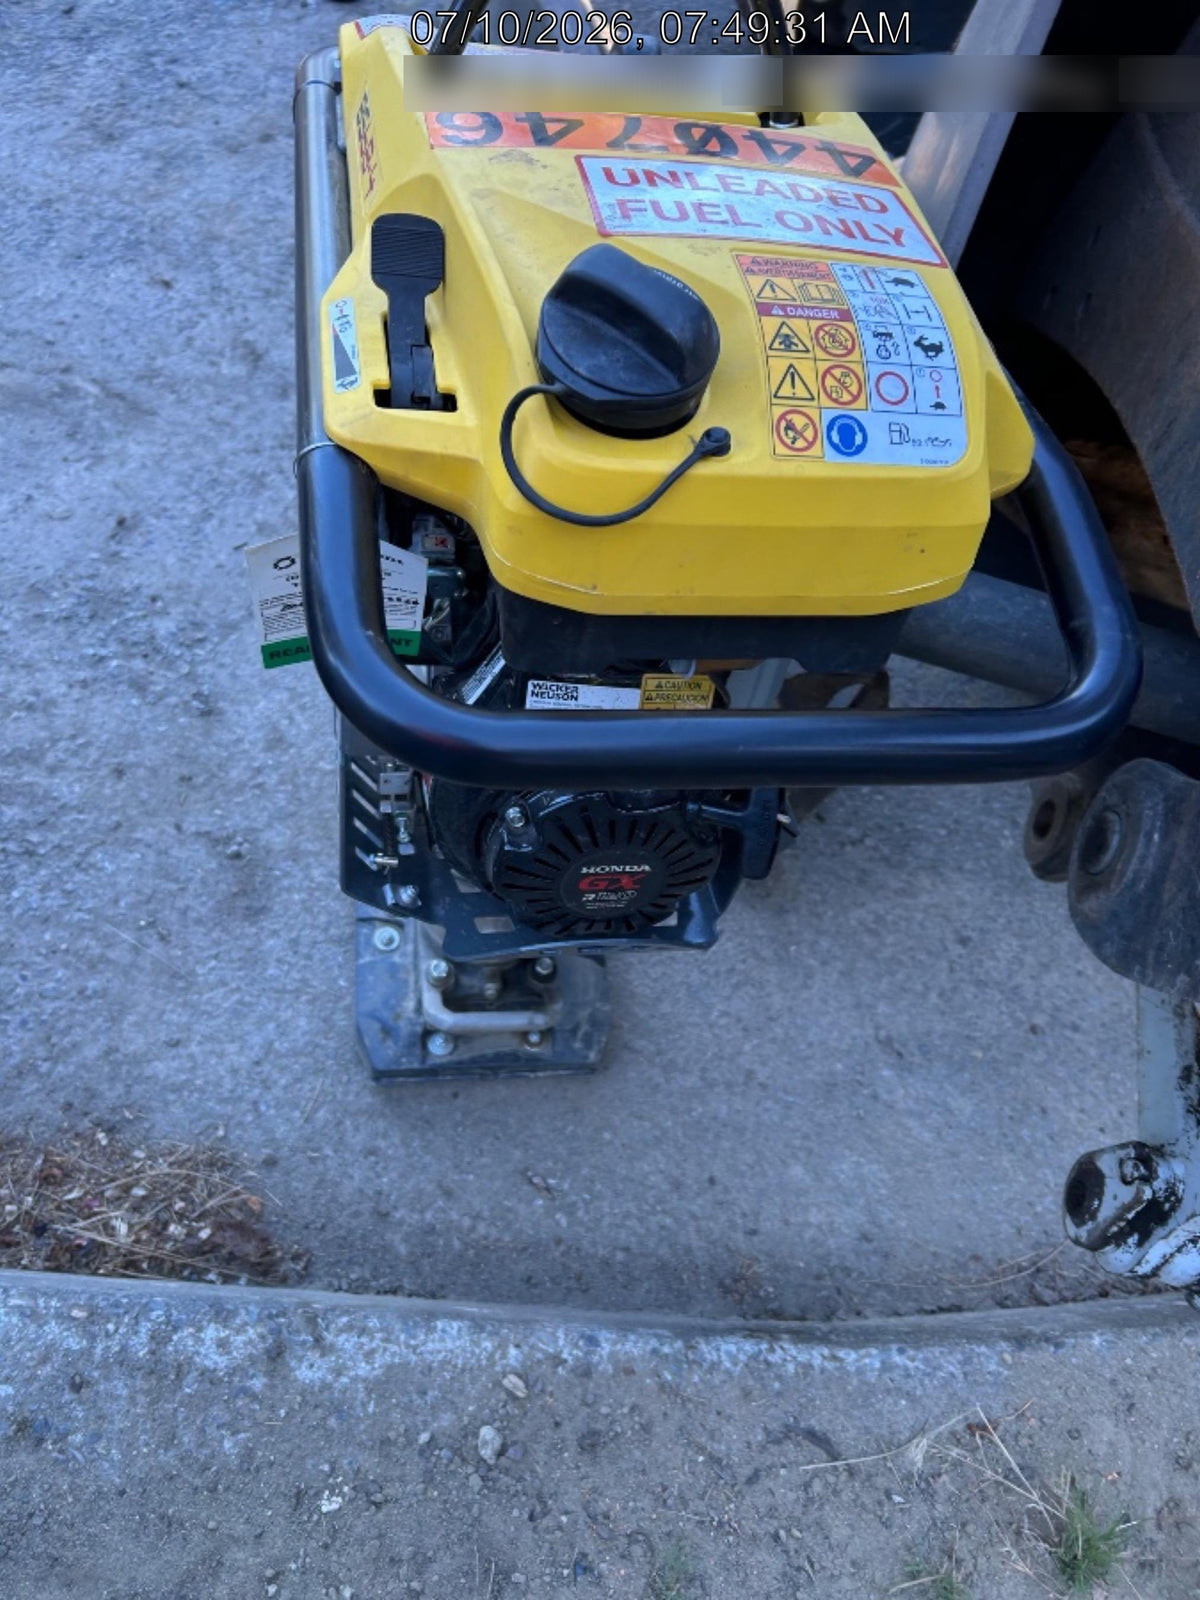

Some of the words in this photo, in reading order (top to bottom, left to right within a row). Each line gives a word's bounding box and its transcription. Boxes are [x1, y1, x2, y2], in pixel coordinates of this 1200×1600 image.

[436, 112, 877, 179] 440746
[602, 165, 890, 215] UNLEADED
[616, 197, 764, 230] FUEL
[777, 209, 908, 248] ONLY
[787, 307, 840, 320] DANGER
[664, 681, 702, 690] CAUTION
[531, 690, 578, 701] NEUSON
[580, 864, 652, 874] HONDA
[578, 873, 647, 891] GX
